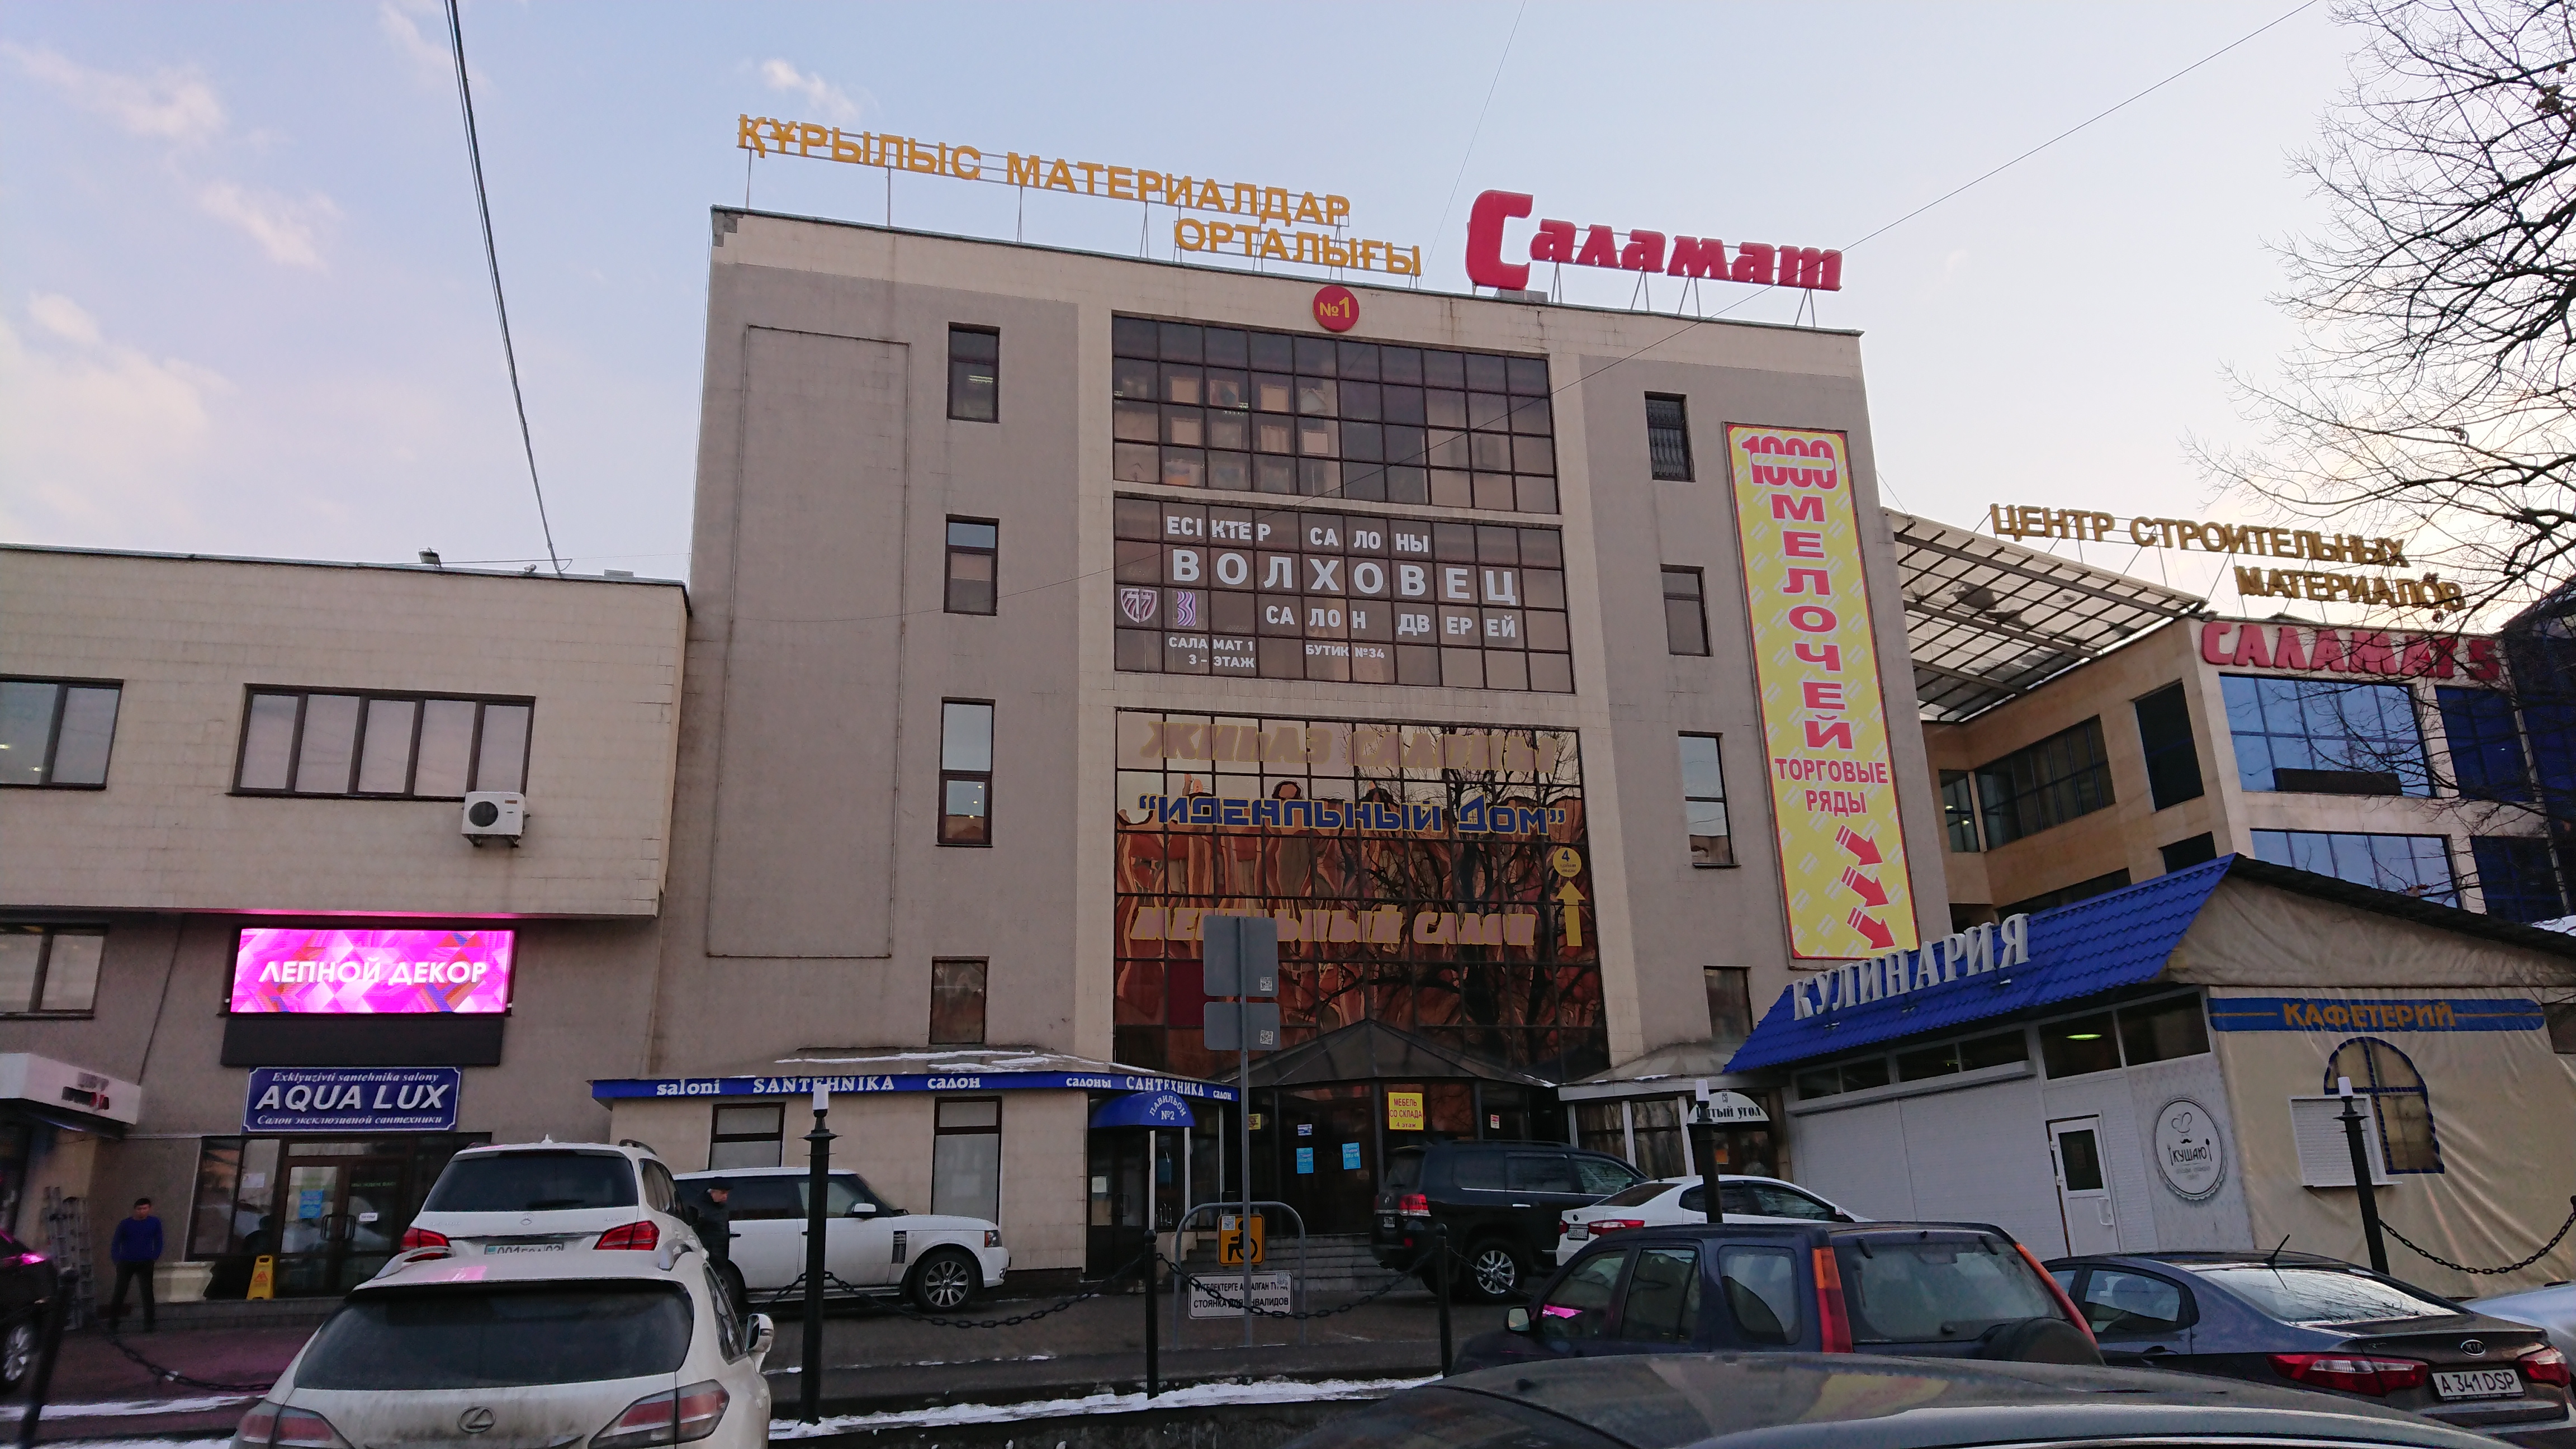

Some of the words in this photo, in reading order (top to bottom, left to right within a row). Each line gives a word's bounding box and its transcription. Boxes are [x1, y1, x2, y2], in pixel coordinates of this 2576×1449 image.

[738, 113, 981, 180] ҚҰРЫЛЫС
[1006, 151, 1350, 226] МАТЕРИАЛДАР
[1174, 218, 1420, 278] ОРТАЛЫҒЫ
[1465, 190, 1842, 291] Саламат
[1320, 296, 1349, 318] №1
[1742, 436, 1837, 489] 1000
[1310, 527, 1428, 553] САЛОНЫ
[1990, 503, 2115, 542] ЦЕНТР
[2130, 517, 2410, 567] СТРОИТЕЛЬНЫХ
[1173, 550, 1516, 605] ВОЛХОВЕЦ
[2233, 566, 2465, 612] МАТЕРИАЛОВ
[1266, 605, 1366, 629] САЛОН
[1398, 613, 1516, 638] ДВЕРЕЙ
[1770, 494, 1853, 749] МЕЛОЧЕЙ
[1168, 637, 1244, 651] САЛАМАТ
[1305, 643, 1349, 657] БУТИК
[1355, 647, 1385, 659] №34
[2201, 623, 2457, 679] САЛАМАТ
[2468, 639, 2500, 680] 5
[1189, 654, 1197, 665] 3
[1213, 655, 1255, 668] ЭТАЖ
[1774, 759, 1889, 784] ТОРГОВЫЕ
[1806, 790, 1867, 817] РЯДЫ
[1562, 850, 1570, 861] 4
[1130, 905, 1402, 943] МЕЬНЫЙ
[1414, 912, 1535, 945] САЛОН
[258, 957, 381, 983] ЛЕПНОЙ
[389, 962, 486, 986] ДЕКОР
[1793, 913, 2030, 1021] КУЛИНАРИЯ
[2283, 1002, 2456, 1027] КАФЕТЕРИЙ
[338, 1072, 399, 1082] santehnika
[402, 1072, 438, 1083] salony
[657, 1079, 720, 1096] saloni
[927, 1077, 981, 1090] салон
[1066, 1078, 1111, 1088] салоны
[1126, 1076, 1204, 1096] САНТЕХНИКА
[1213, 1090, 1232, 1100] салон
[254, 1085, 362, 1112] AQUA
[372, 1085, 448, 1109] LUX
[1149, 1095, 1186, 1117] ПАВИЛЬОН
[257, 1115, 292, 1125] Салон
[1161, 1110, 1175, 1120] №2
[1399, 1110, 1422, 1119] СКЛАДА
[2172, 1147, 2207, 1162] КУШАЮ
[1250, 1298, 1289, 1307] НВАЛИДОВ
[2466, 1343, 2483, 1352] KIA
[2441, 1375, 2453, 1393] A
[2452, 1374, 2482, 1392] 341
[2483, 1372, 2515, 1390] DSP
